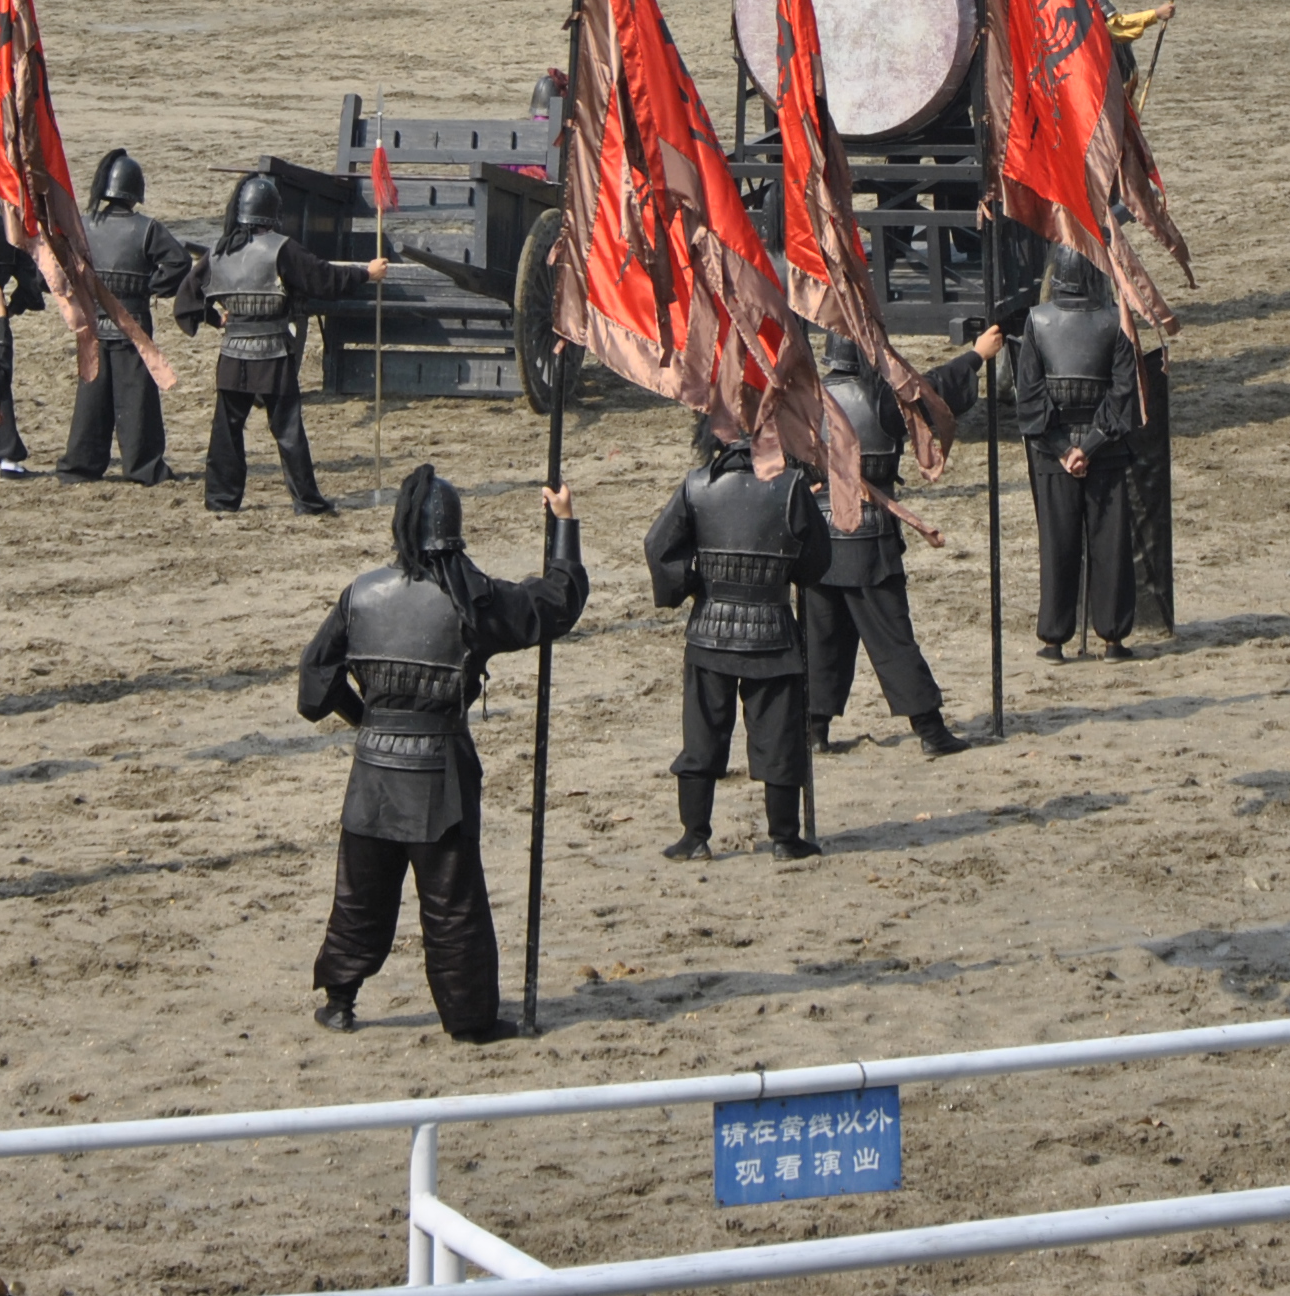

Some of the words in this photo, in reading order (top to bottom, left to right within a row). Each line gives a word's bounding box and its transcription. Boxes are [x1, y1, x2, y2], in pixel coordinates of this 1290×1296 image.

[721, 1106, 894, 1148] 请在黄线以外
[735, 1147, 880, 1186] 观看演出
